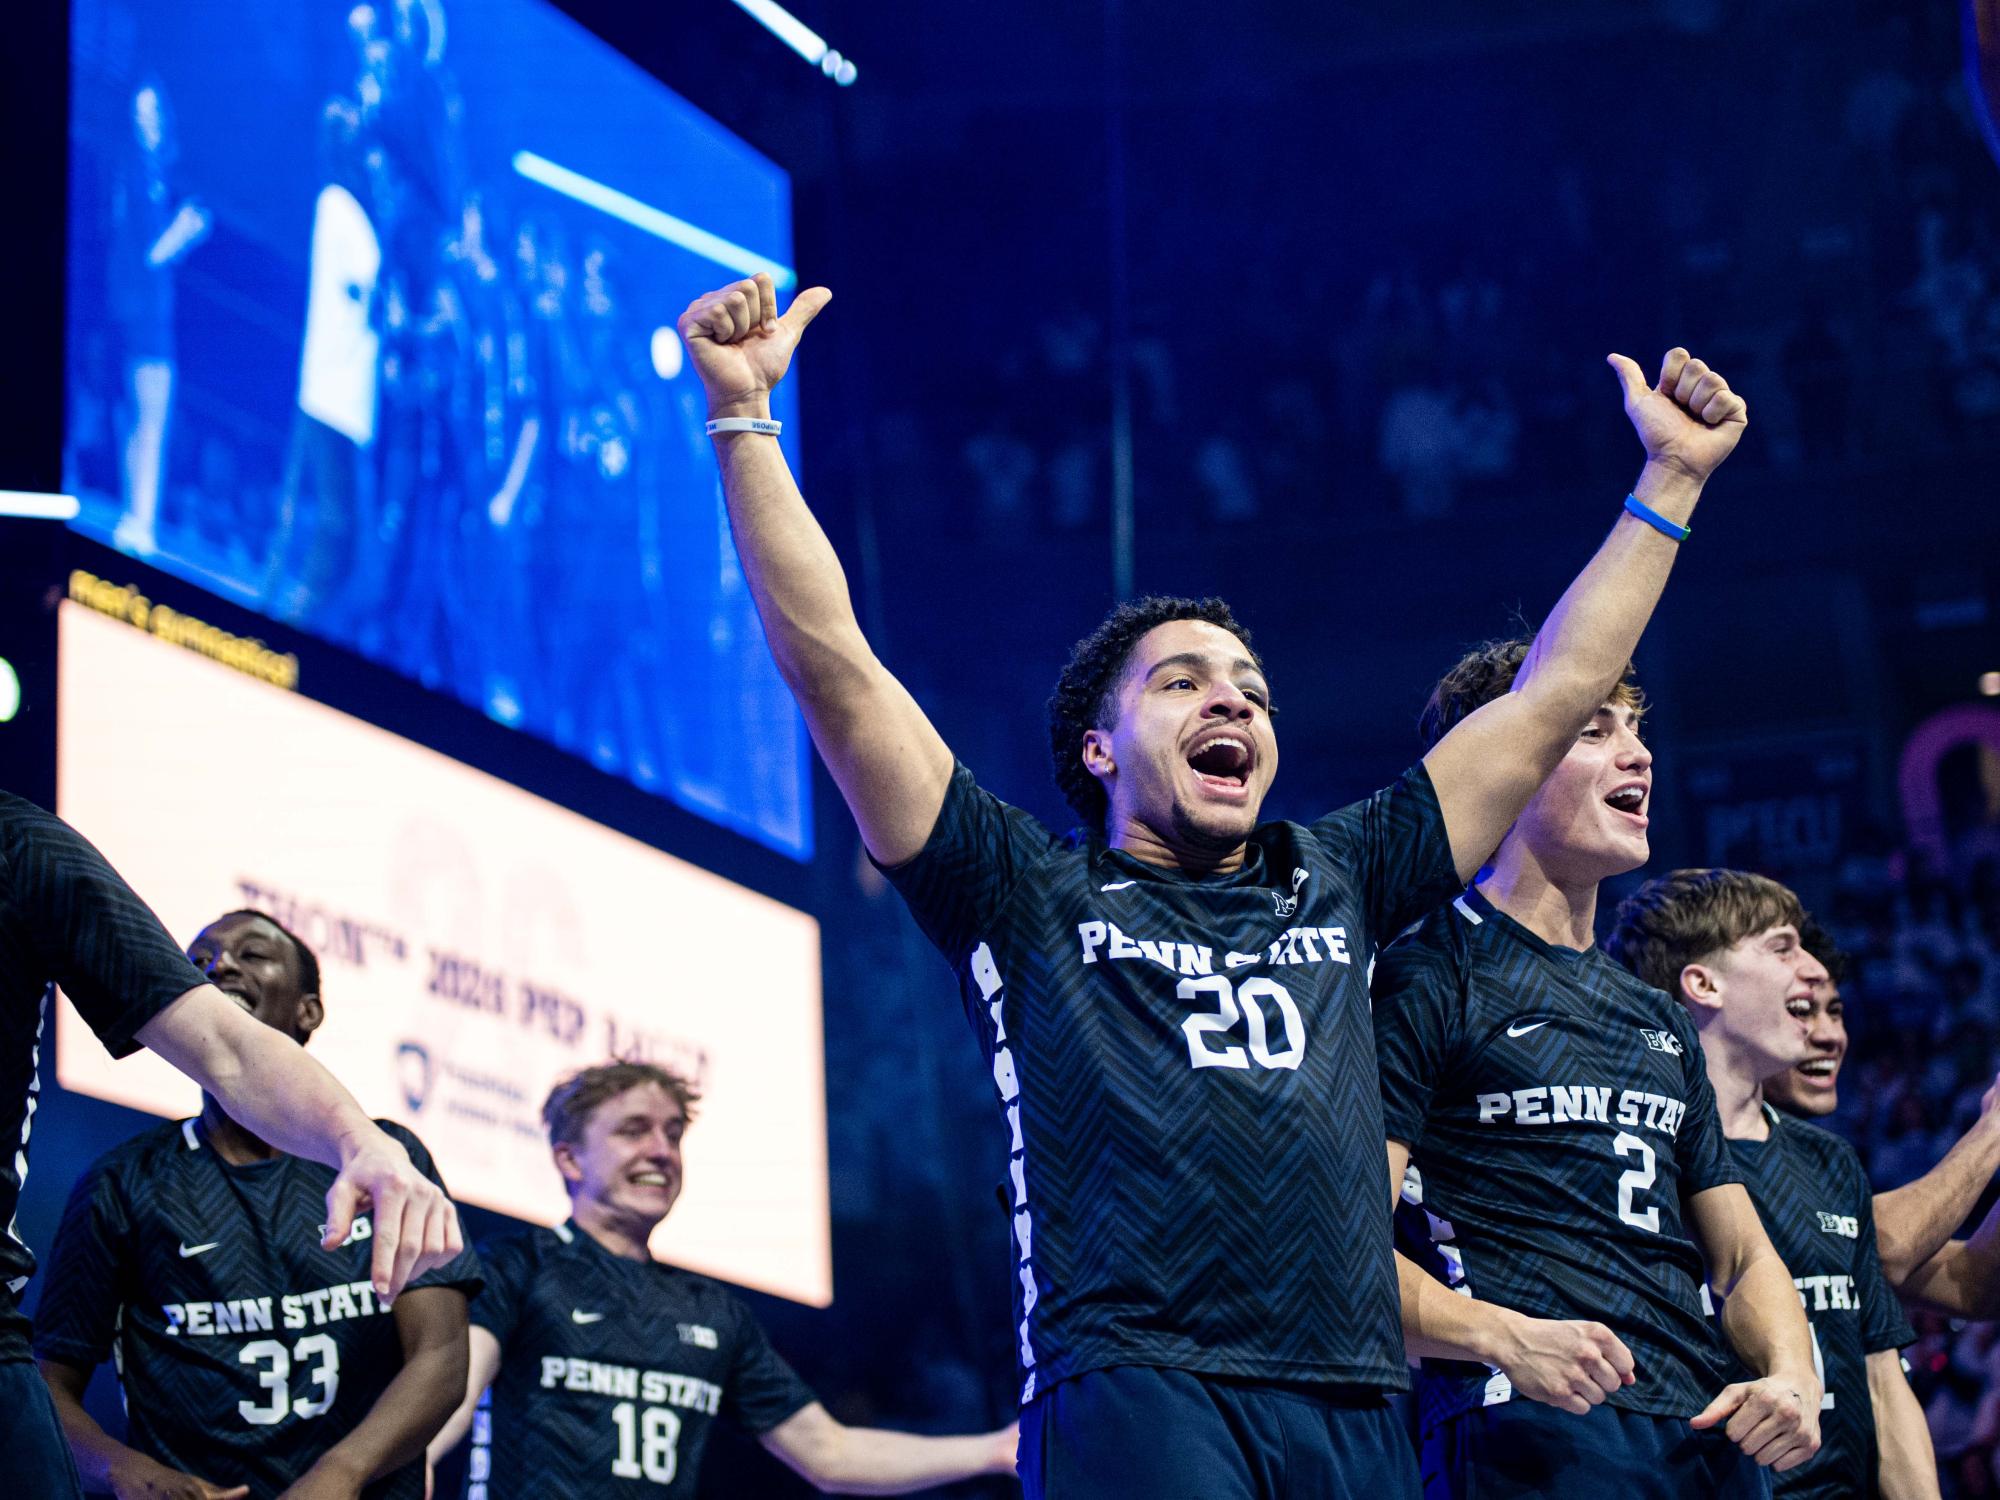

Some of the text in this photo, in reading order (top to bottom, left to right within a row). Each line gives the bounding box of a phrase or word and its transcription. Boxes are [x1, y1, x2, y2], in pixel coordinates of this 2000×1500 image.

[1078, 921, 1213, 975] PENN
[1177, 974, 1306, 1070] 20
[1476, 1086, 1611, 1125] PENN
[1613, 1131, 1659, 1233] 2
[163, 1280, 392, 1336] PENN STAT
[238, 1333, 340, 1425] 33
[540, 1356, 639, 1399] PENN
[611, 1402, 681, 1485] 18
